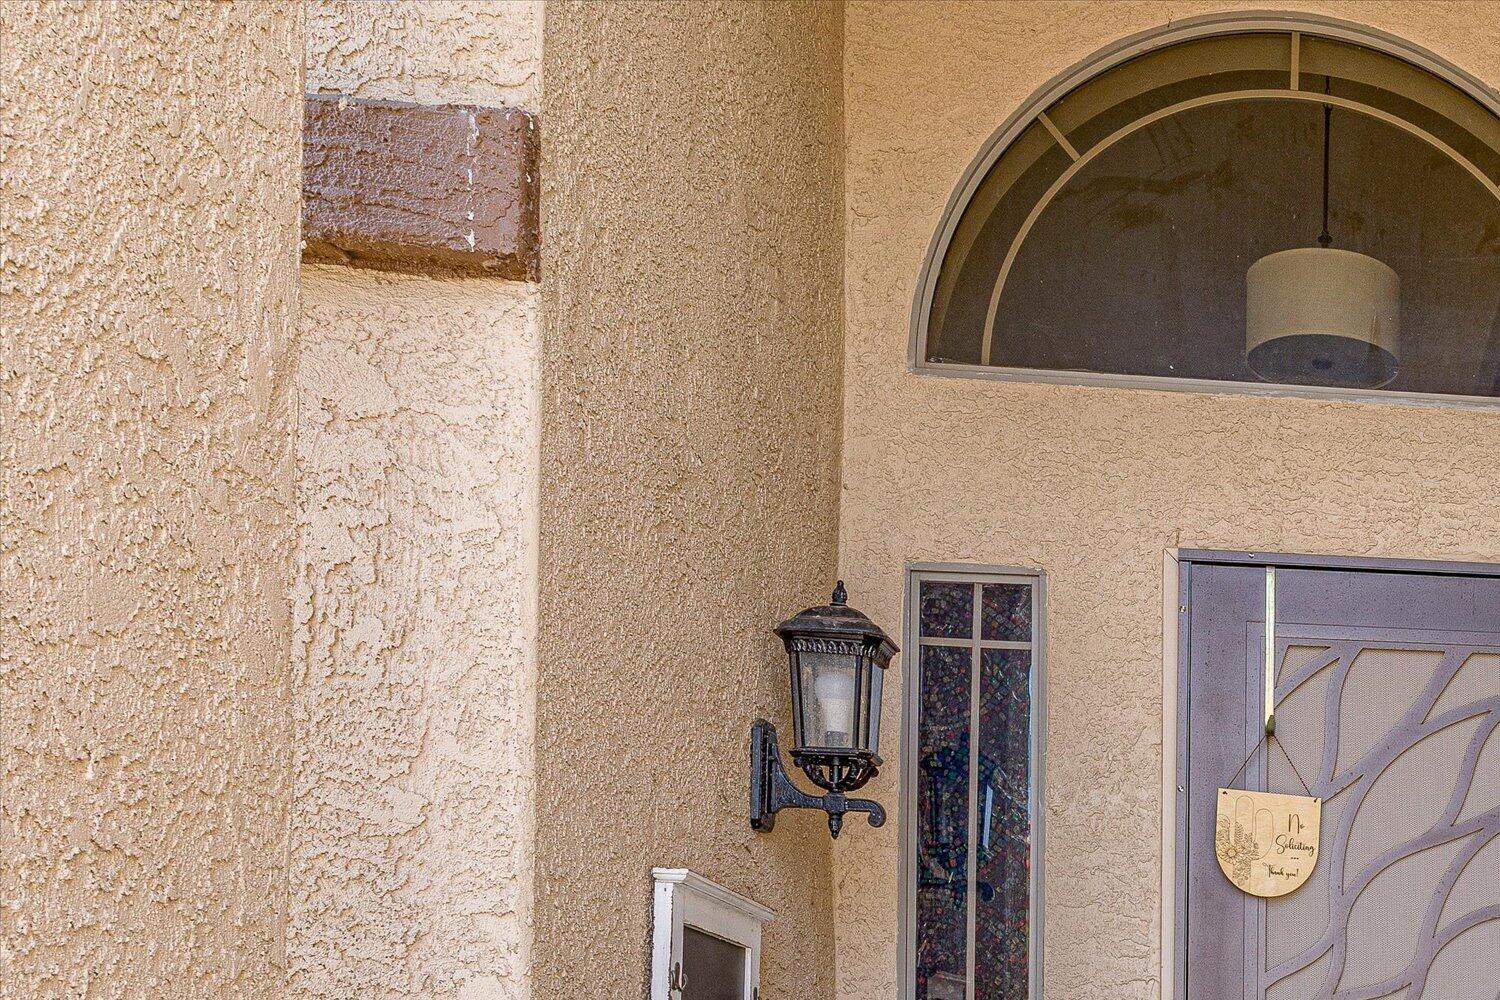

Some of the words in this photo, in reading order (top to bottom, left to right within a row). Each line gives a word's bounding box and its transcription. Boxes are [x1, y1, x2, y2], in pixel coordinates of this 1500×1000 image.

[1288, 813, 1305, 834] No
[1275, 834, 1315, 857] Soliciting
[1262, 862, 1285, 878] Thank
[1286, 868, 1299, 880] you!
